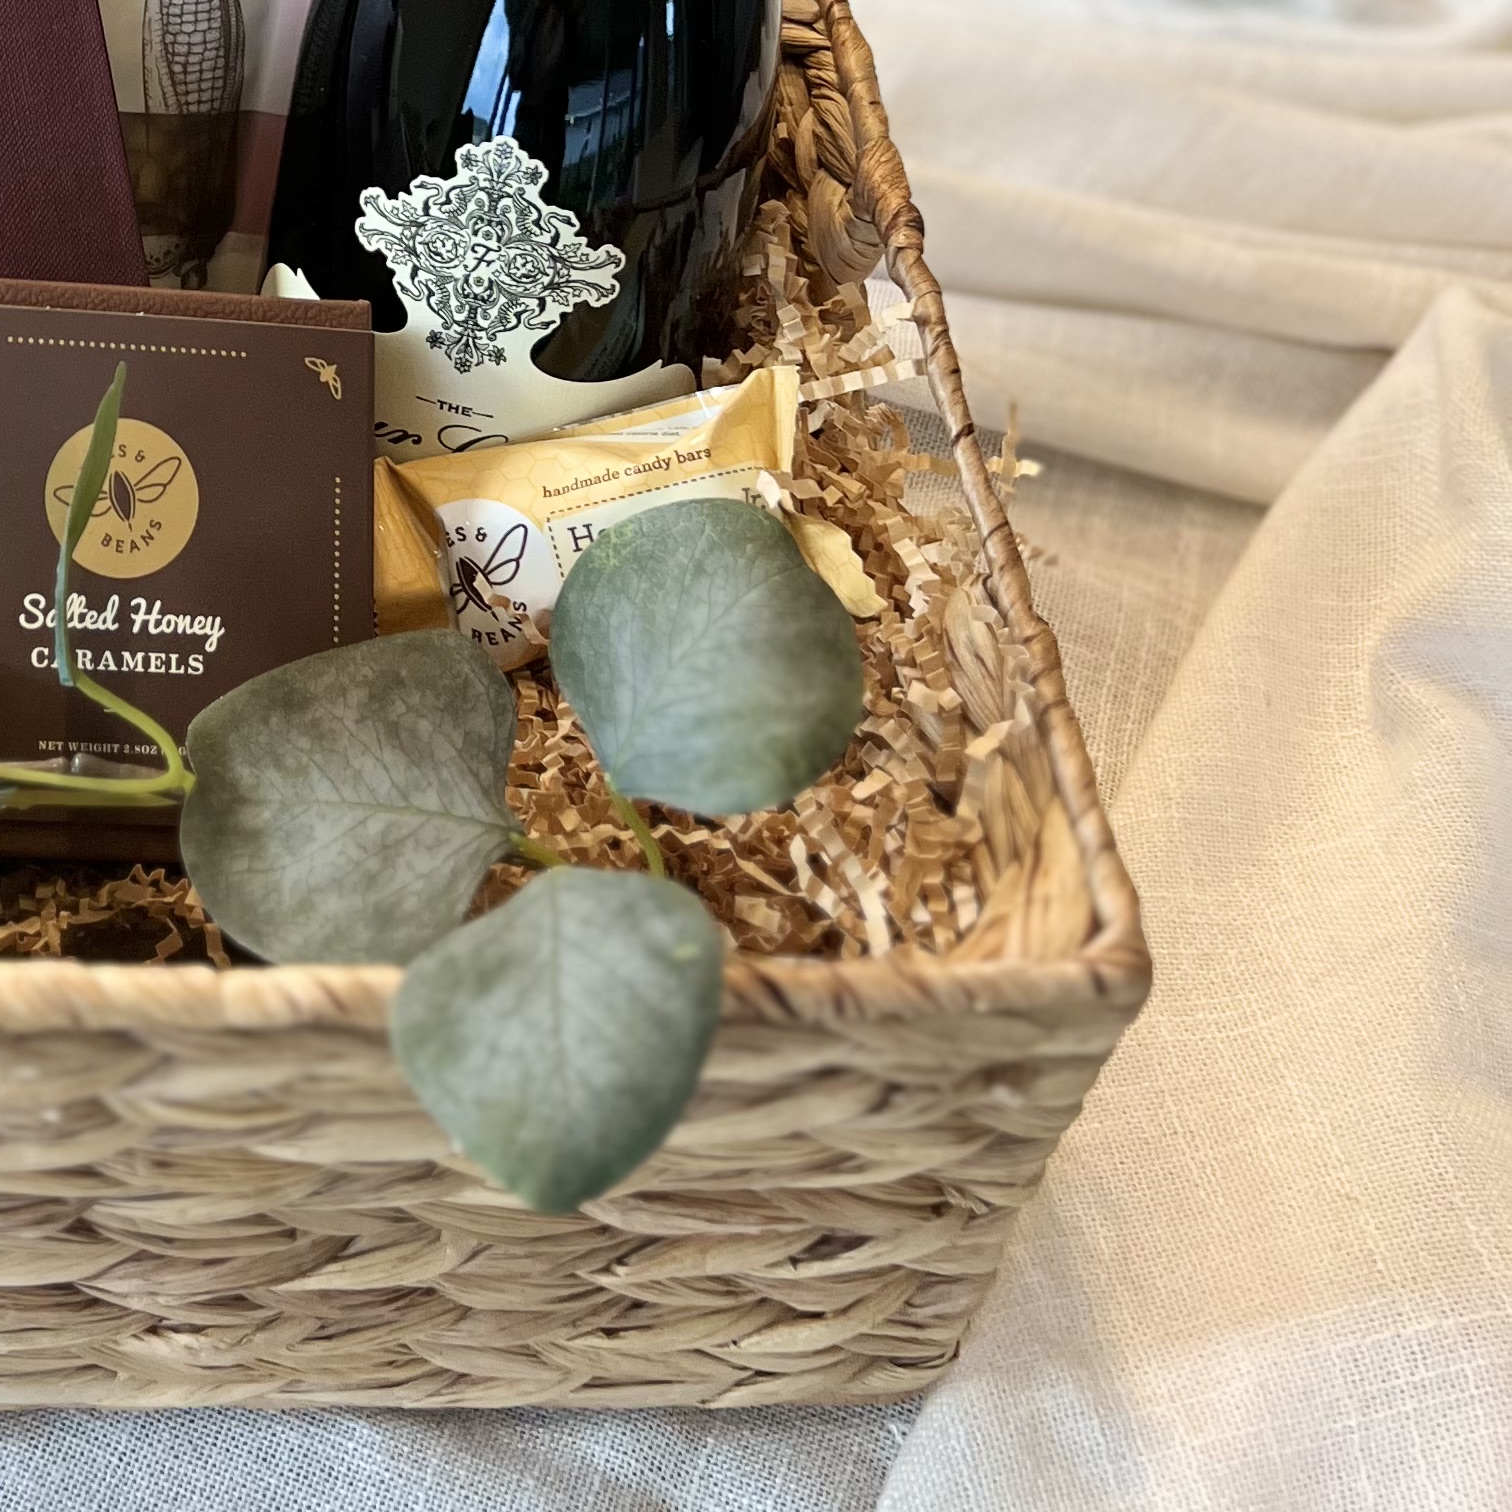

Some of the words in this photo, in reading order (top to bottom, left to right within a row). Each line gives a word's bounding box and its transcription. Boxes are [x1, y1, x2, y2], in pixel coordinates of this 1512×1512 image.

[436, 399, 473, 417] THE
[542, 467, 620, 499] handmade
[624, 456, 672, 478] candy
[674, 446, 712, 465] bars
[100, 519, 162, 554] BEANS
[130, 597, 226, 653] Honey
[30, 646, 205, 675] CRAMELS
[38, 740, 64, 751] NET
[68, 741, 120, 754] WEIGHT
